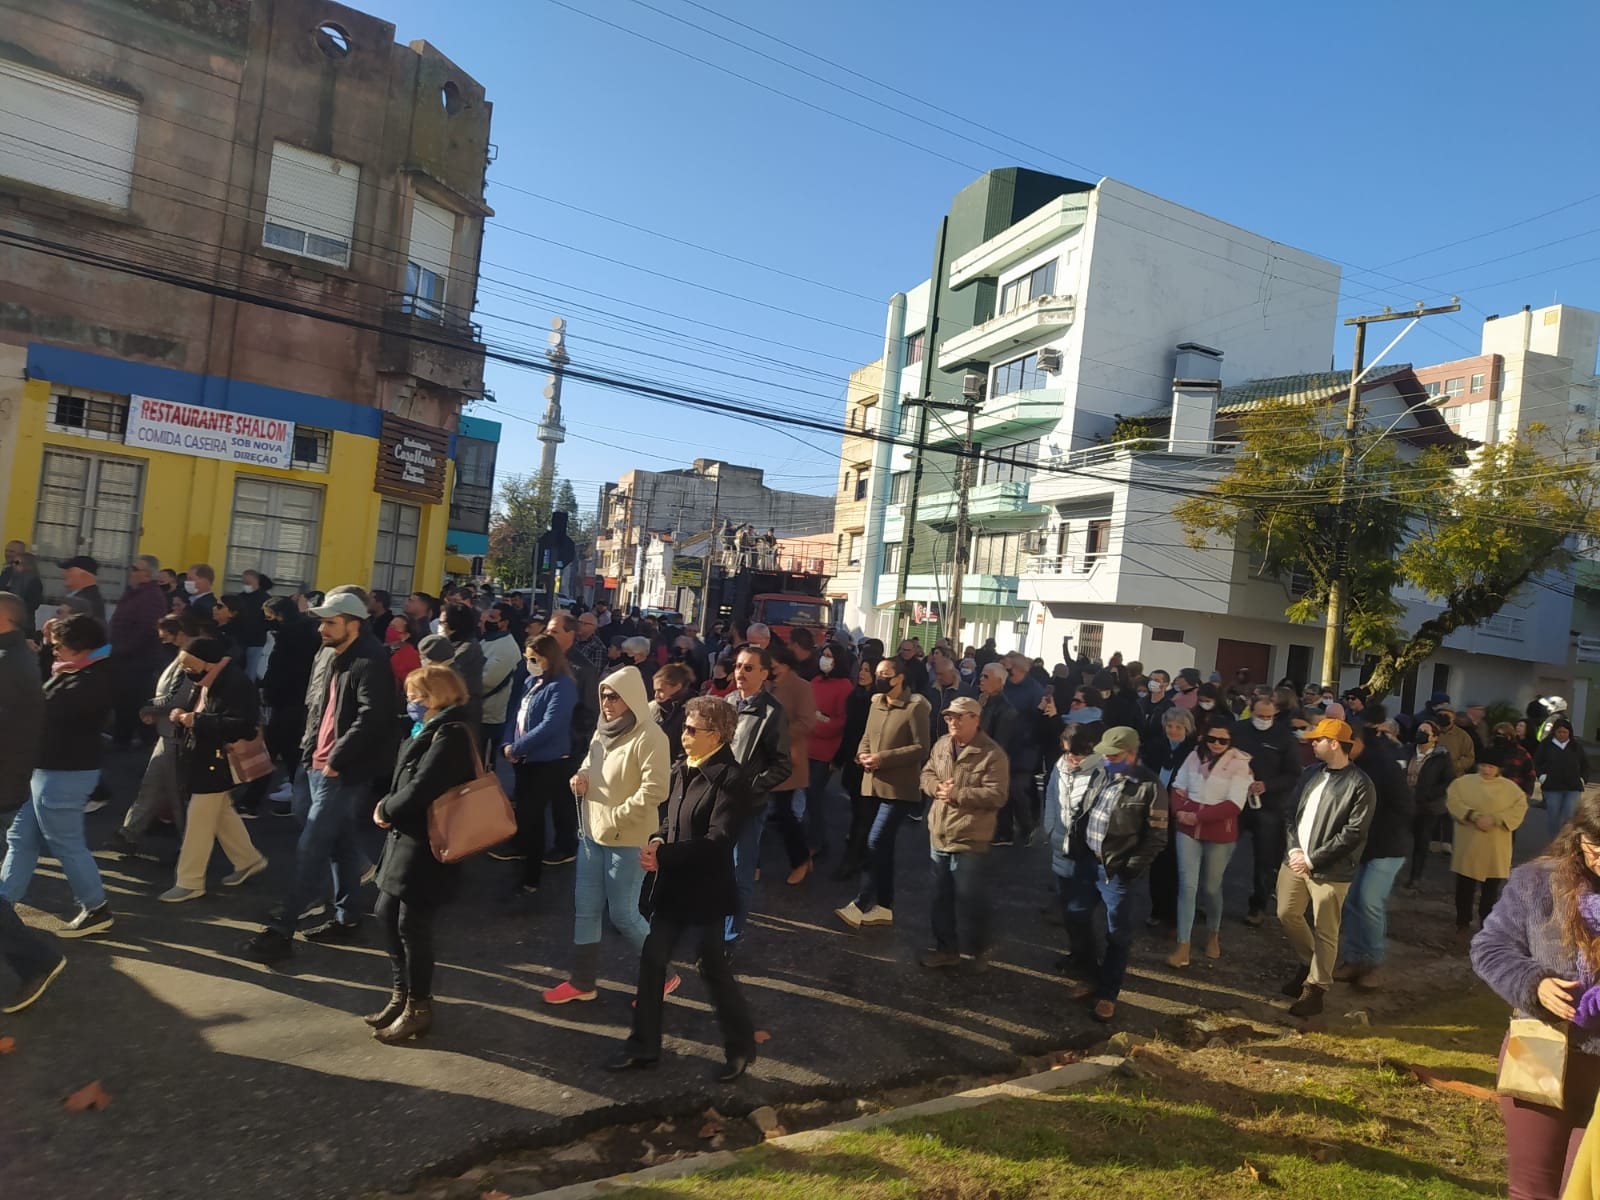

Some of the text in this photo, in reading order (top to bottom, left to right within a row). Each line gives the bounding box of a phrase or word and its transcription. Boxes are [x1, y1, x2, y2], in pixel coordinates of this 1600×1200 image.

[140, 400, 288, 442] RESTAURANTE SHALOM
[138, 427, 228, 453] COMIDA CASEIRA
[231, 437, 283, 453] SOB NOVA
